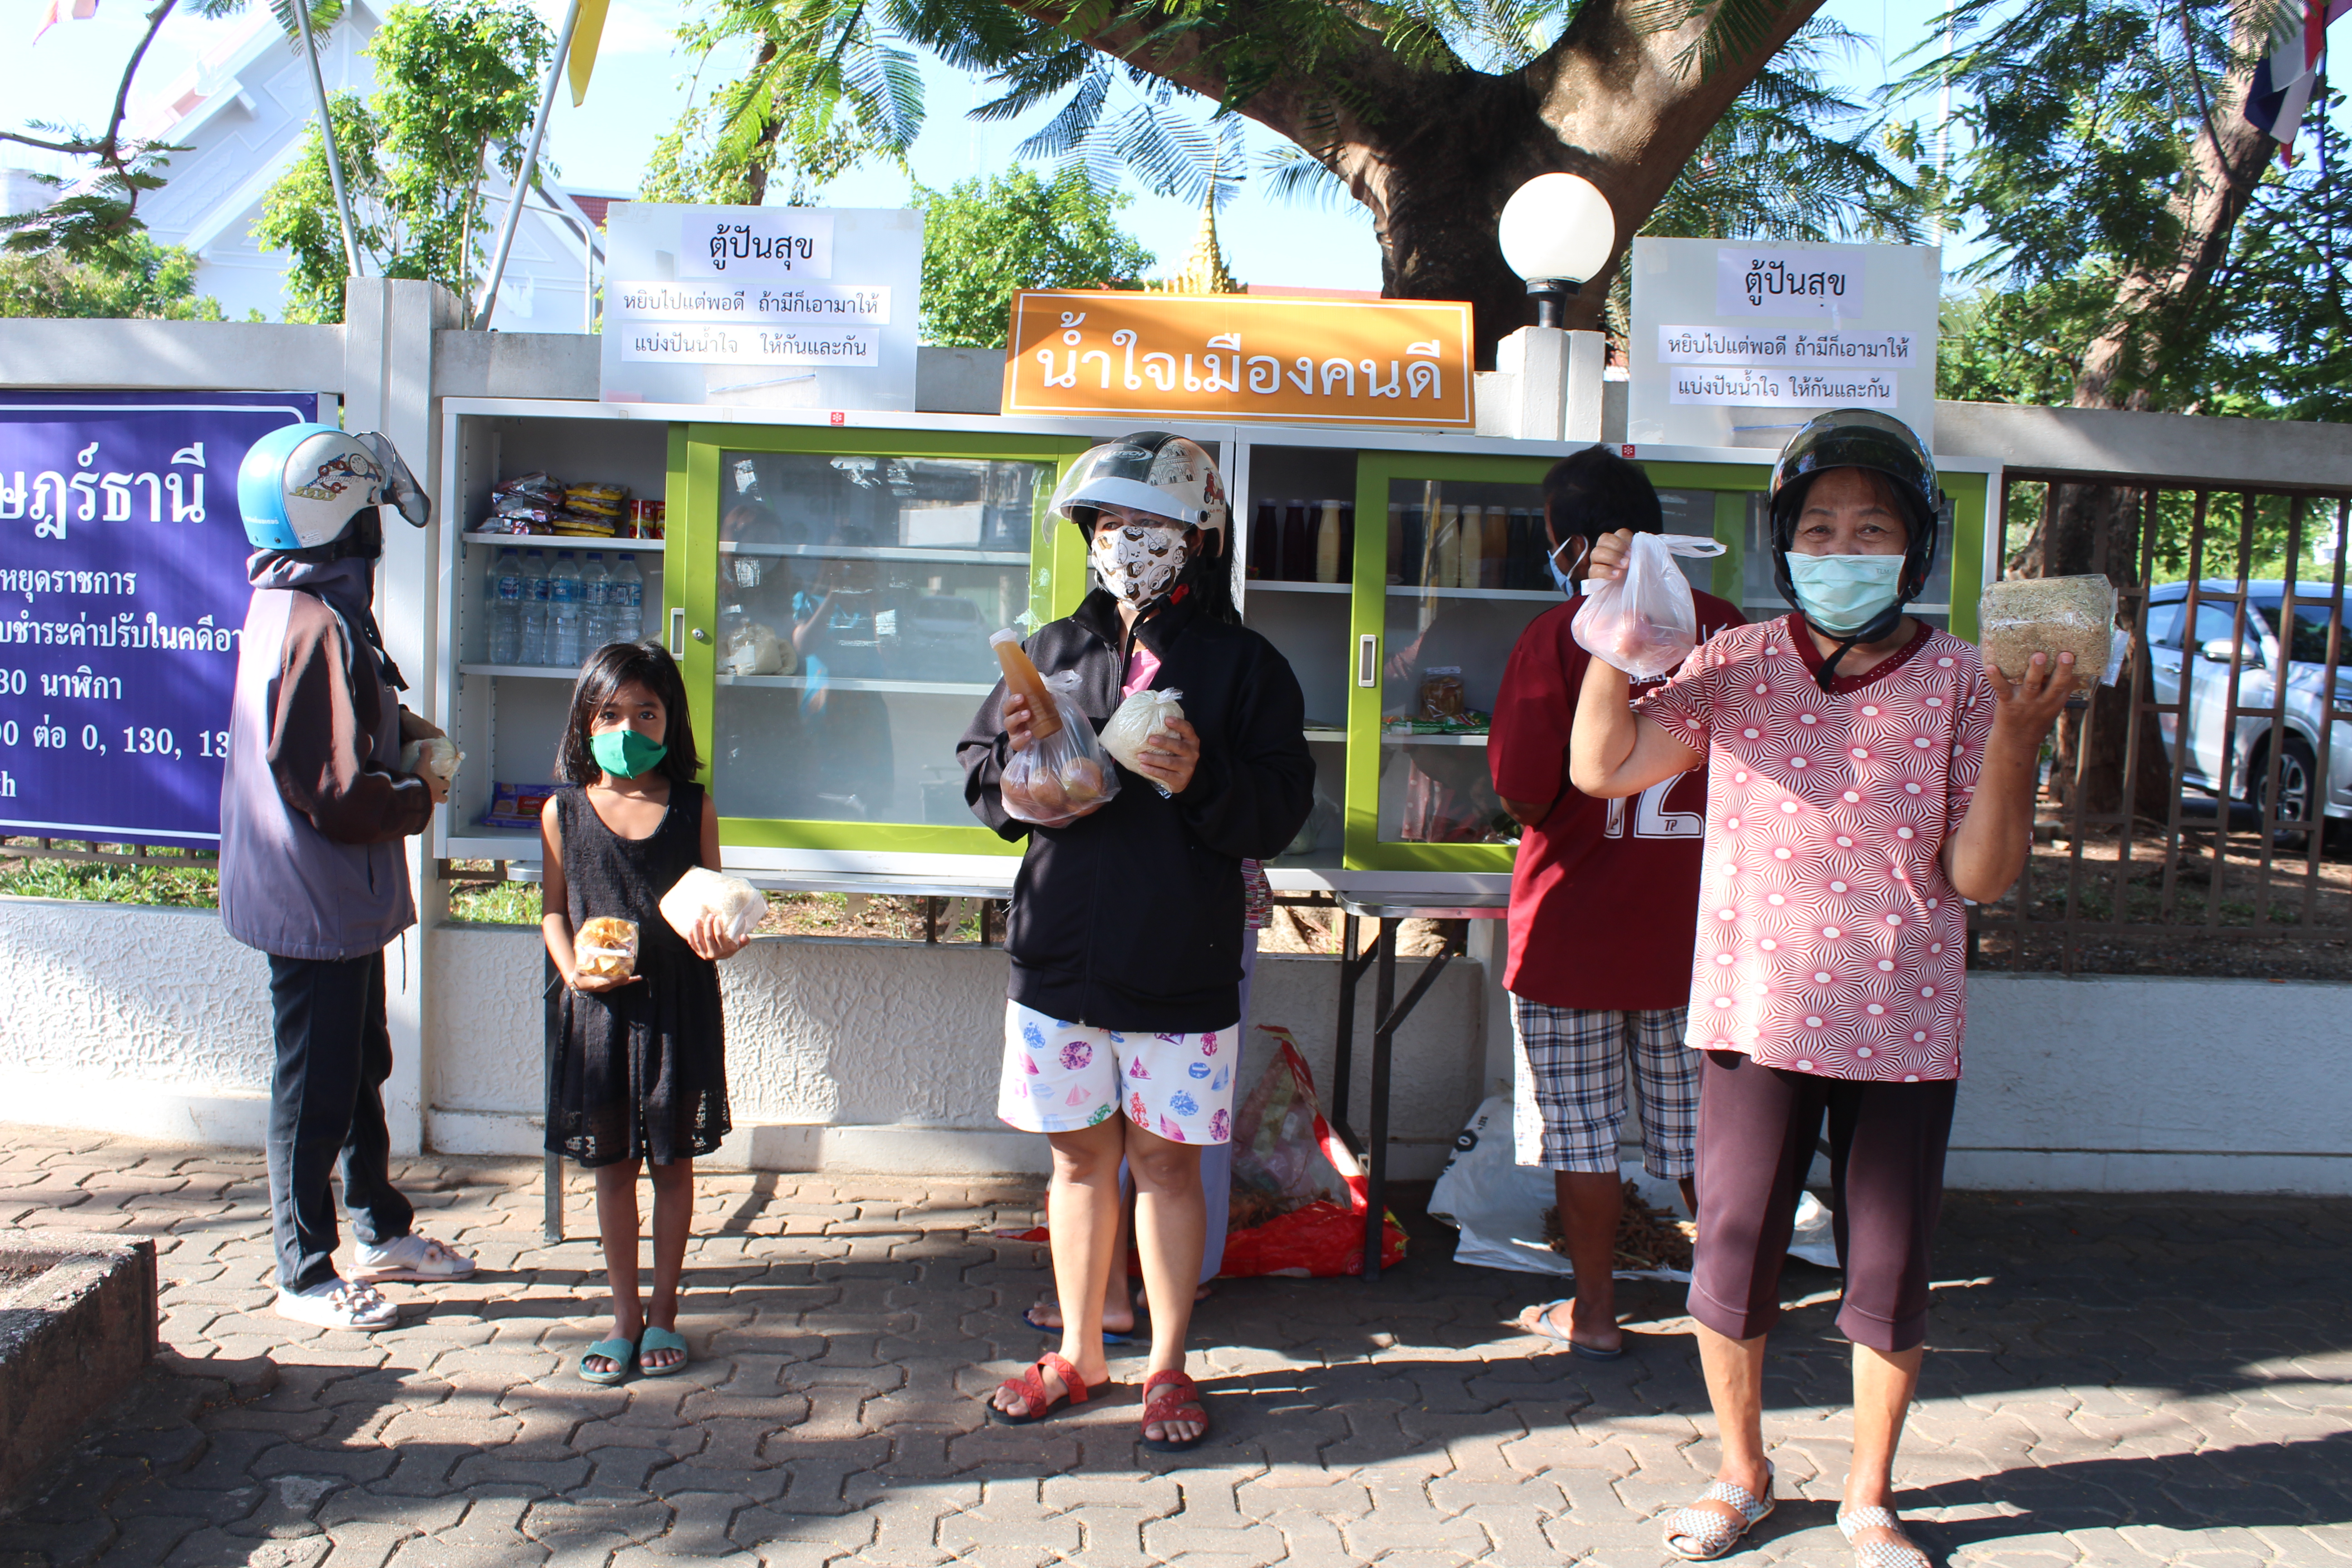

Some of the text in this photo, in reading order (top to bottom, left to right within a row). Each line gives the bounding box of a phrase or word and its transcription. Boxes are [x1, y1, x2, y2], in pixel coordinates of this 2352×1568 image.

[710, 224, 814, 271] ตู้ปันสุข
[1745, 259, 1846, 307] ตู้ปันสุข
[623, 289, 878, 314] หยิบไปแต่พอดี ถ้ามีก็เอามาให้
[635, 326, 867, 356] แบ่งปันน้ำใจ ให้กันและกัน
[1036, 311, 1442, 399] น้ำใจเมืองคนดี
[1668, 333, 1909, 358] หยิบไปแต่พอดี ถ้ามีก็เอามาให้
[1678, 370, 1890, 399] แบ่งปันน้ำใจ ให้กันและกัน
[40, 665, 122, 700] นาฬิกา
[33, 714, 67, 749] ต่อ
[82, 724, 107, 757] 0,
[123, 726, 182, 761] 130,
